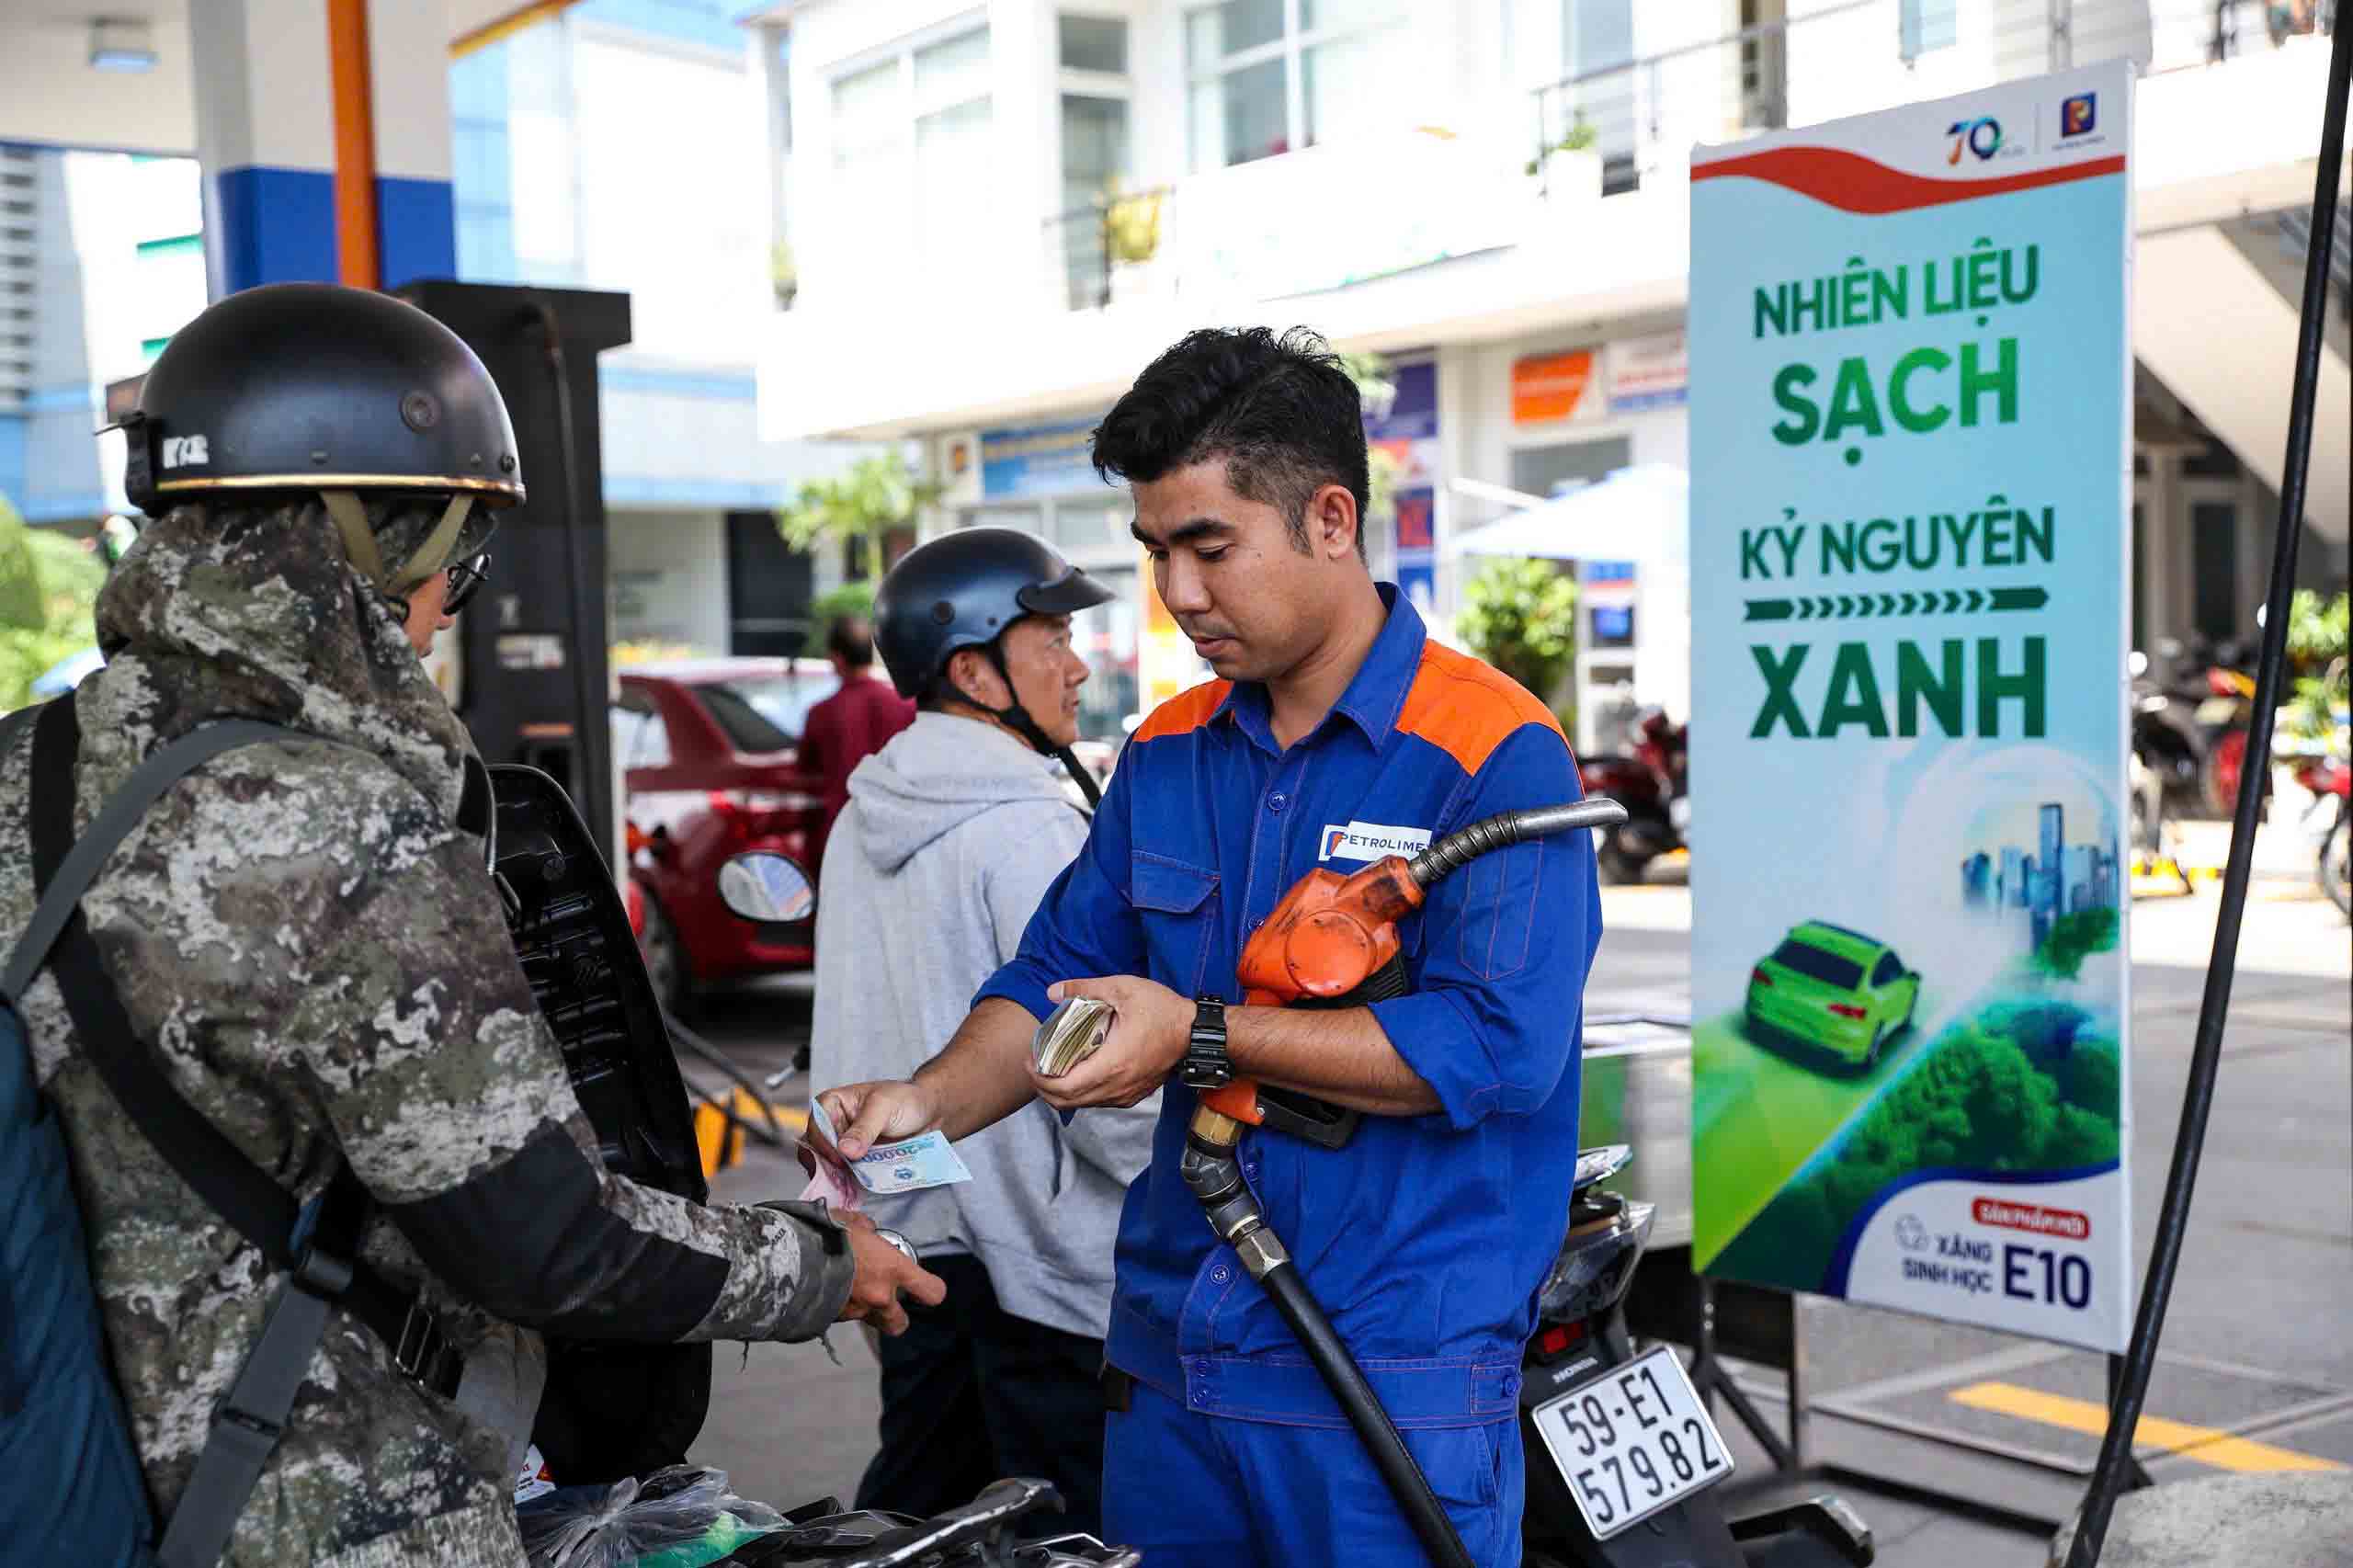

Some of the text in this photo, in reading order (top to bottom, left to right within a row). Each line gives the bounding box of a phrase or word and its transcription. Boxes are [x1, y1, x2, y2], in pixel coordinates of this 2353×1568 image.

[1753, 236, 2040, 339] NHIÊN LIỆU
[1770, 336, 2019, 467] SẠCH
[1740, 494, 2055, 581] KỶ NGUYÊN
[1747, 634, 2047, 739] XANH
[2004, 1243, 2091, 1311] E10
[1558, 1366, 1673, 1457] 59-E1
[1575, 1418, 1721, 1524] 579.82
